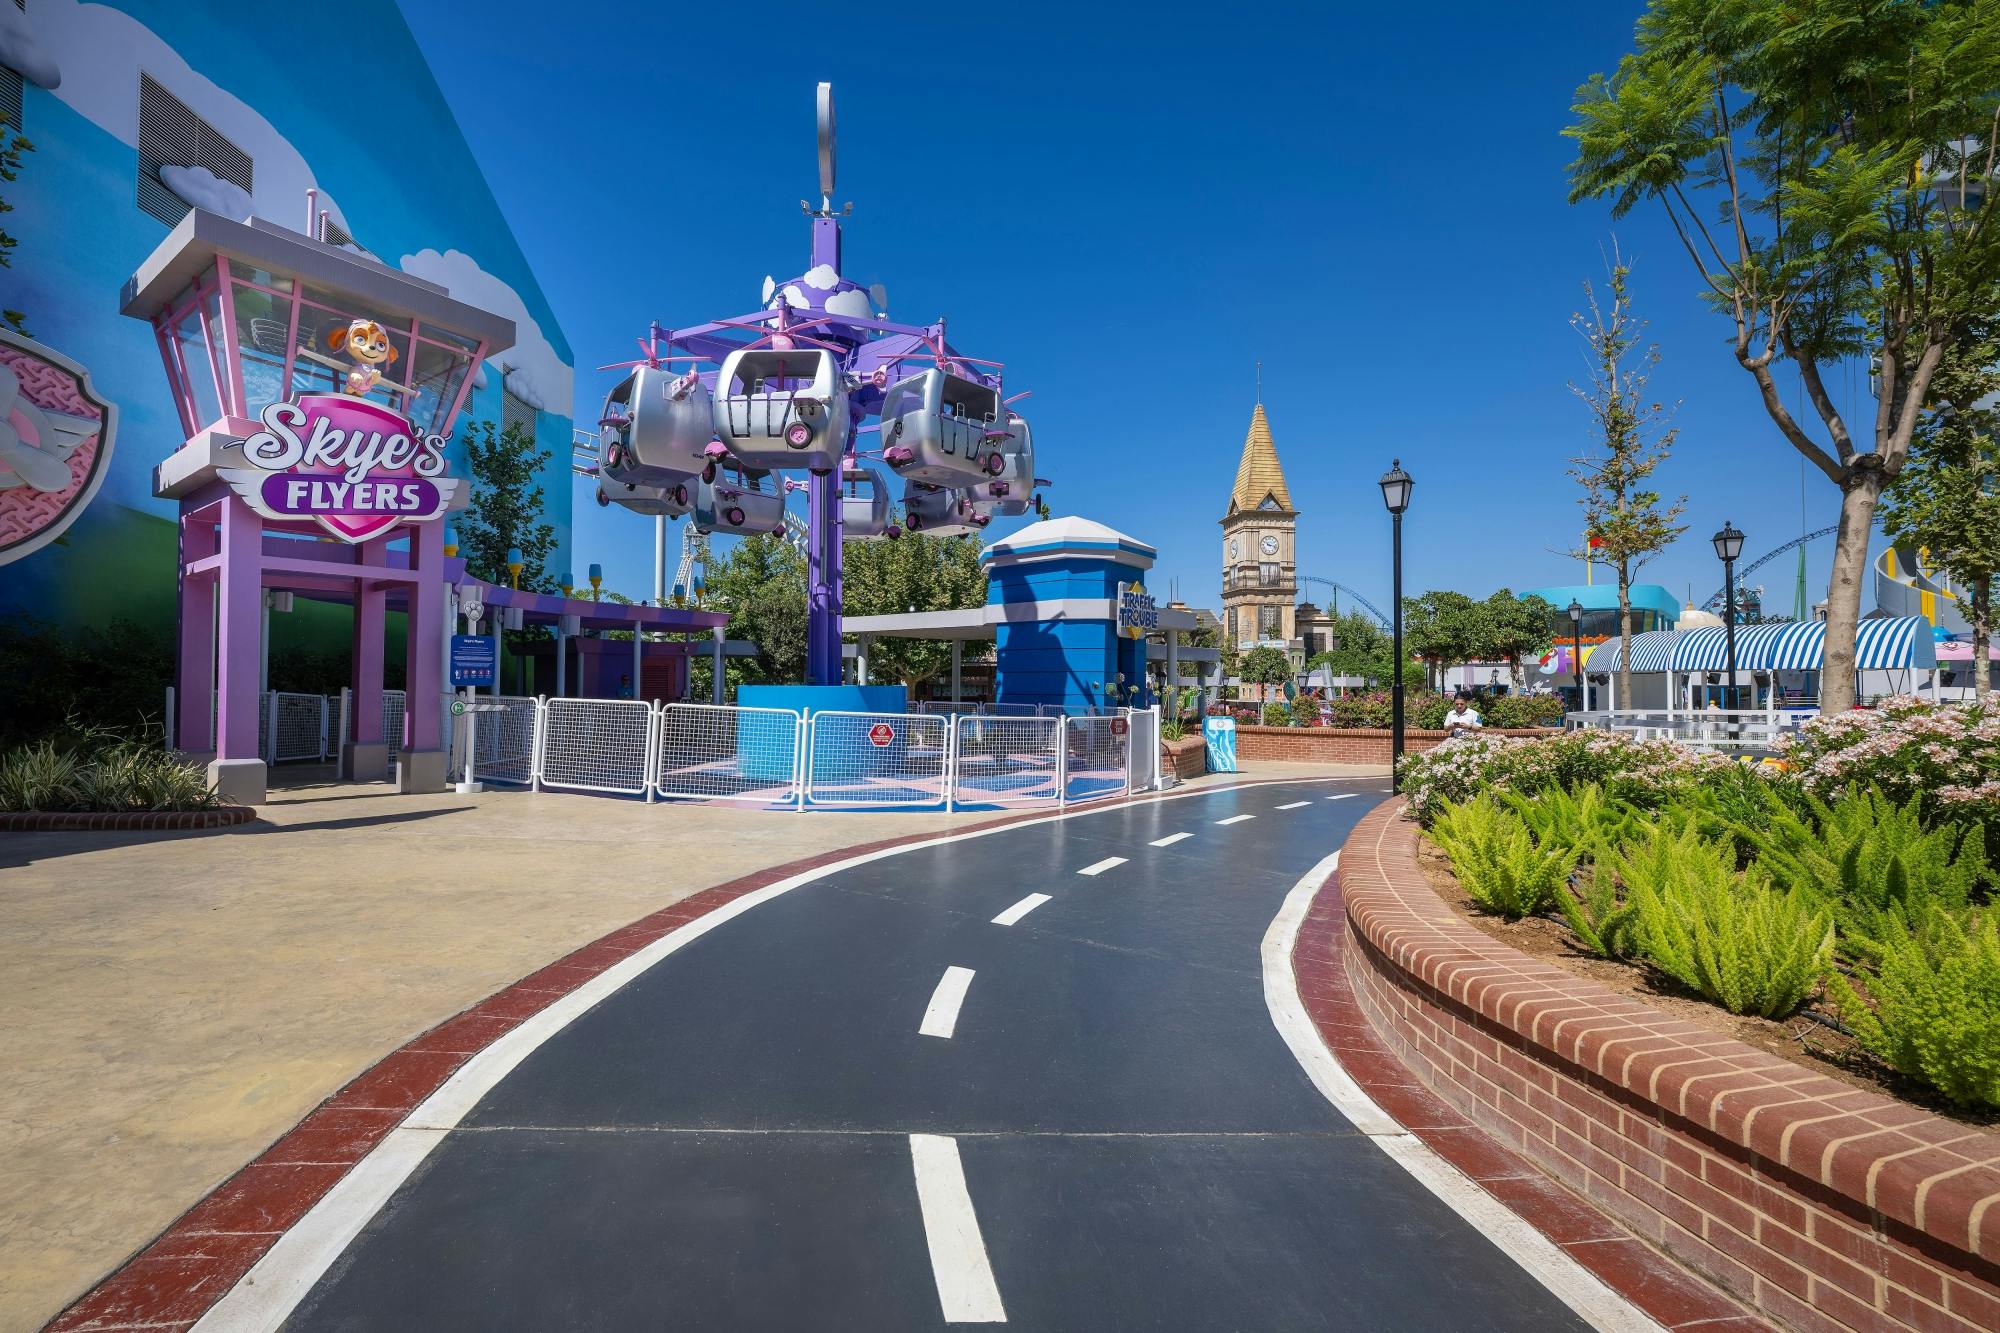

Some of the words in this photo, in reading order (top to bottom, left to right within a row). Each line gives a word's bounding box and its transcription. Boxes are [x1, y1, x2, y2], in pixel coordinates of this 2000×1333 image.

[221, 402, 453, 484] Skye's
[286, 479, 420, 511] FLYERS
[1123, 592, 1156, 611] TRAFFIC
[1119, 608, 1158, 629] TROUBLE
